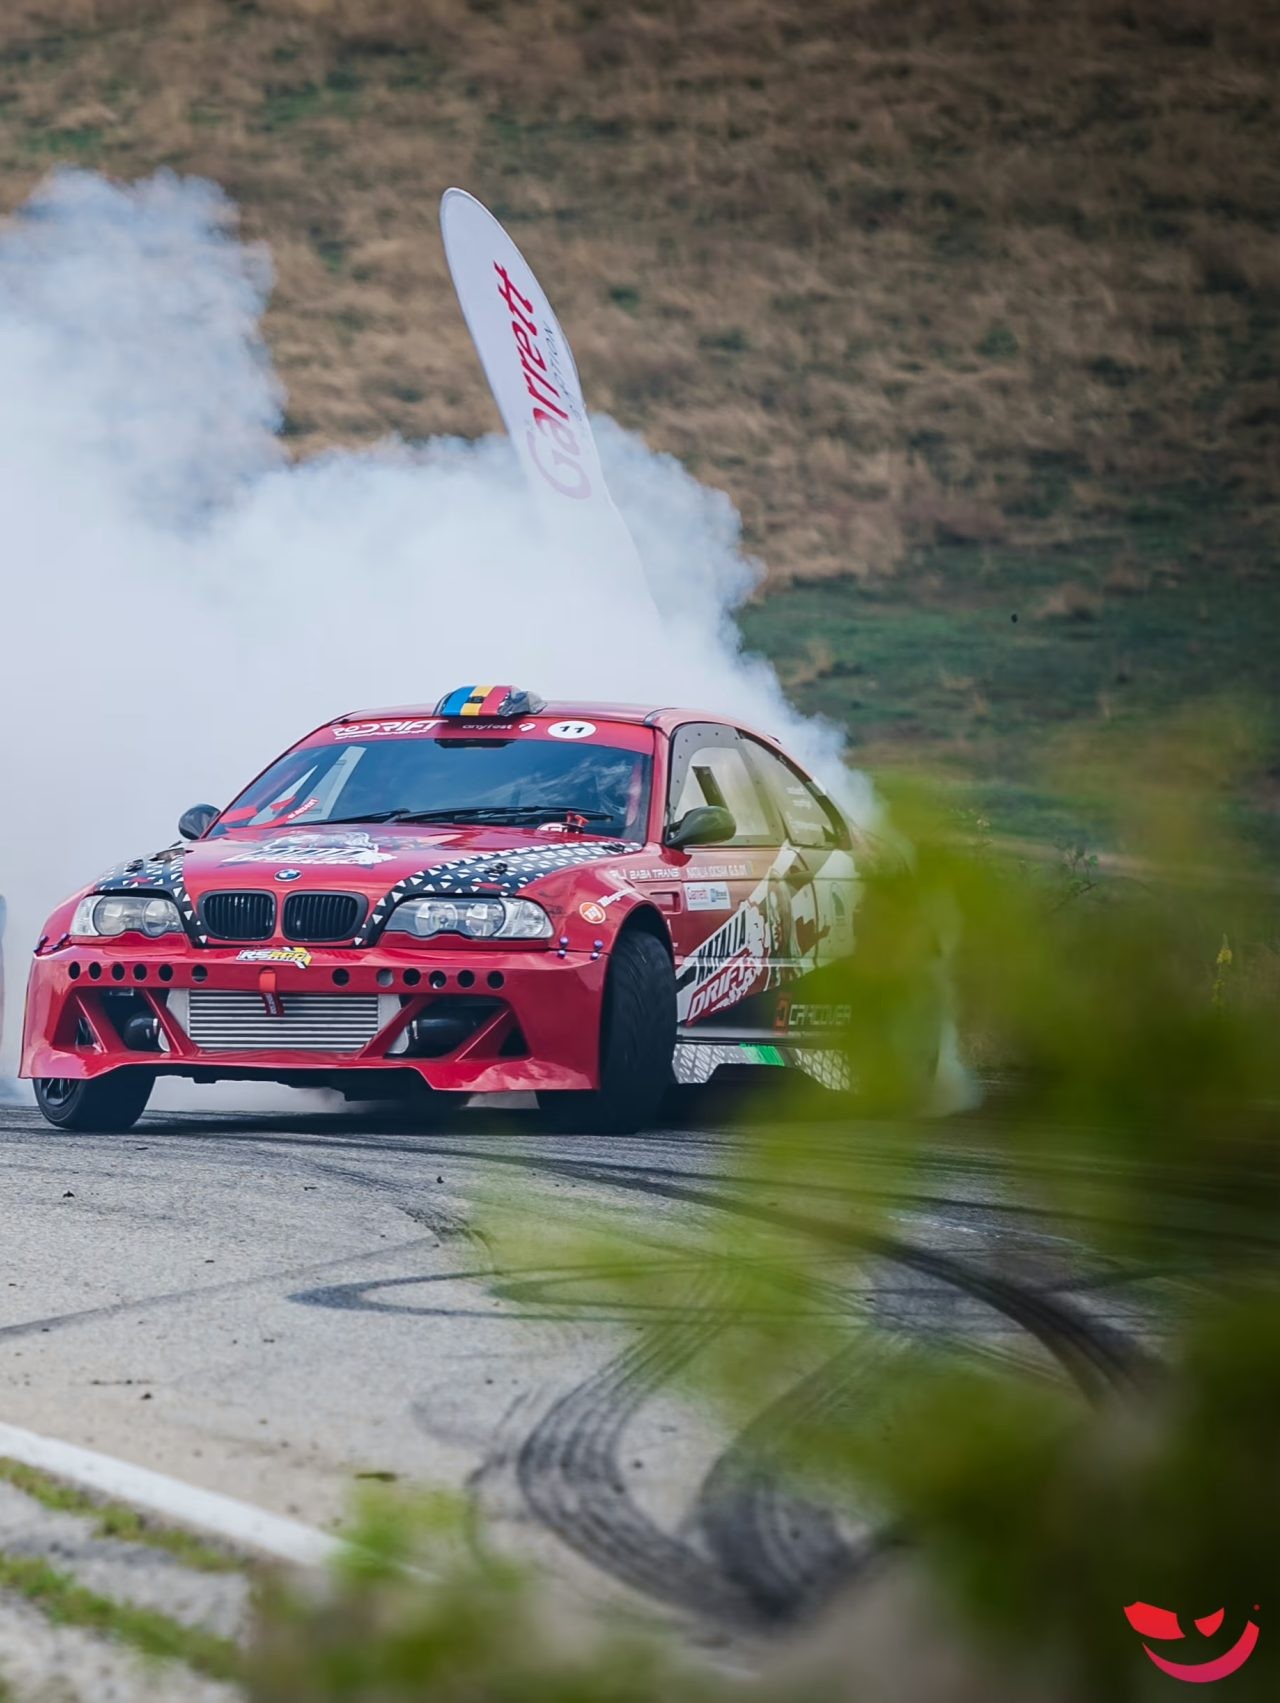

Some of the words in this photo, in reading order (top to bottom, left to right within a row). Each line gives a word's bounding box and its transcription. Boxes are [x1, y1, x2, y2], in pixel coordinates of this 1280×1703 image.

[493, 259, 592, 500] Garrett
[332, 719, 449, 738] RODRIFT
[462, 722, 512, 732] anyfest
[559, 724, 586, 734] 11
[696, 908, 747, 987] NATALIA
[687, 955, 752, 1022] DRIFT
